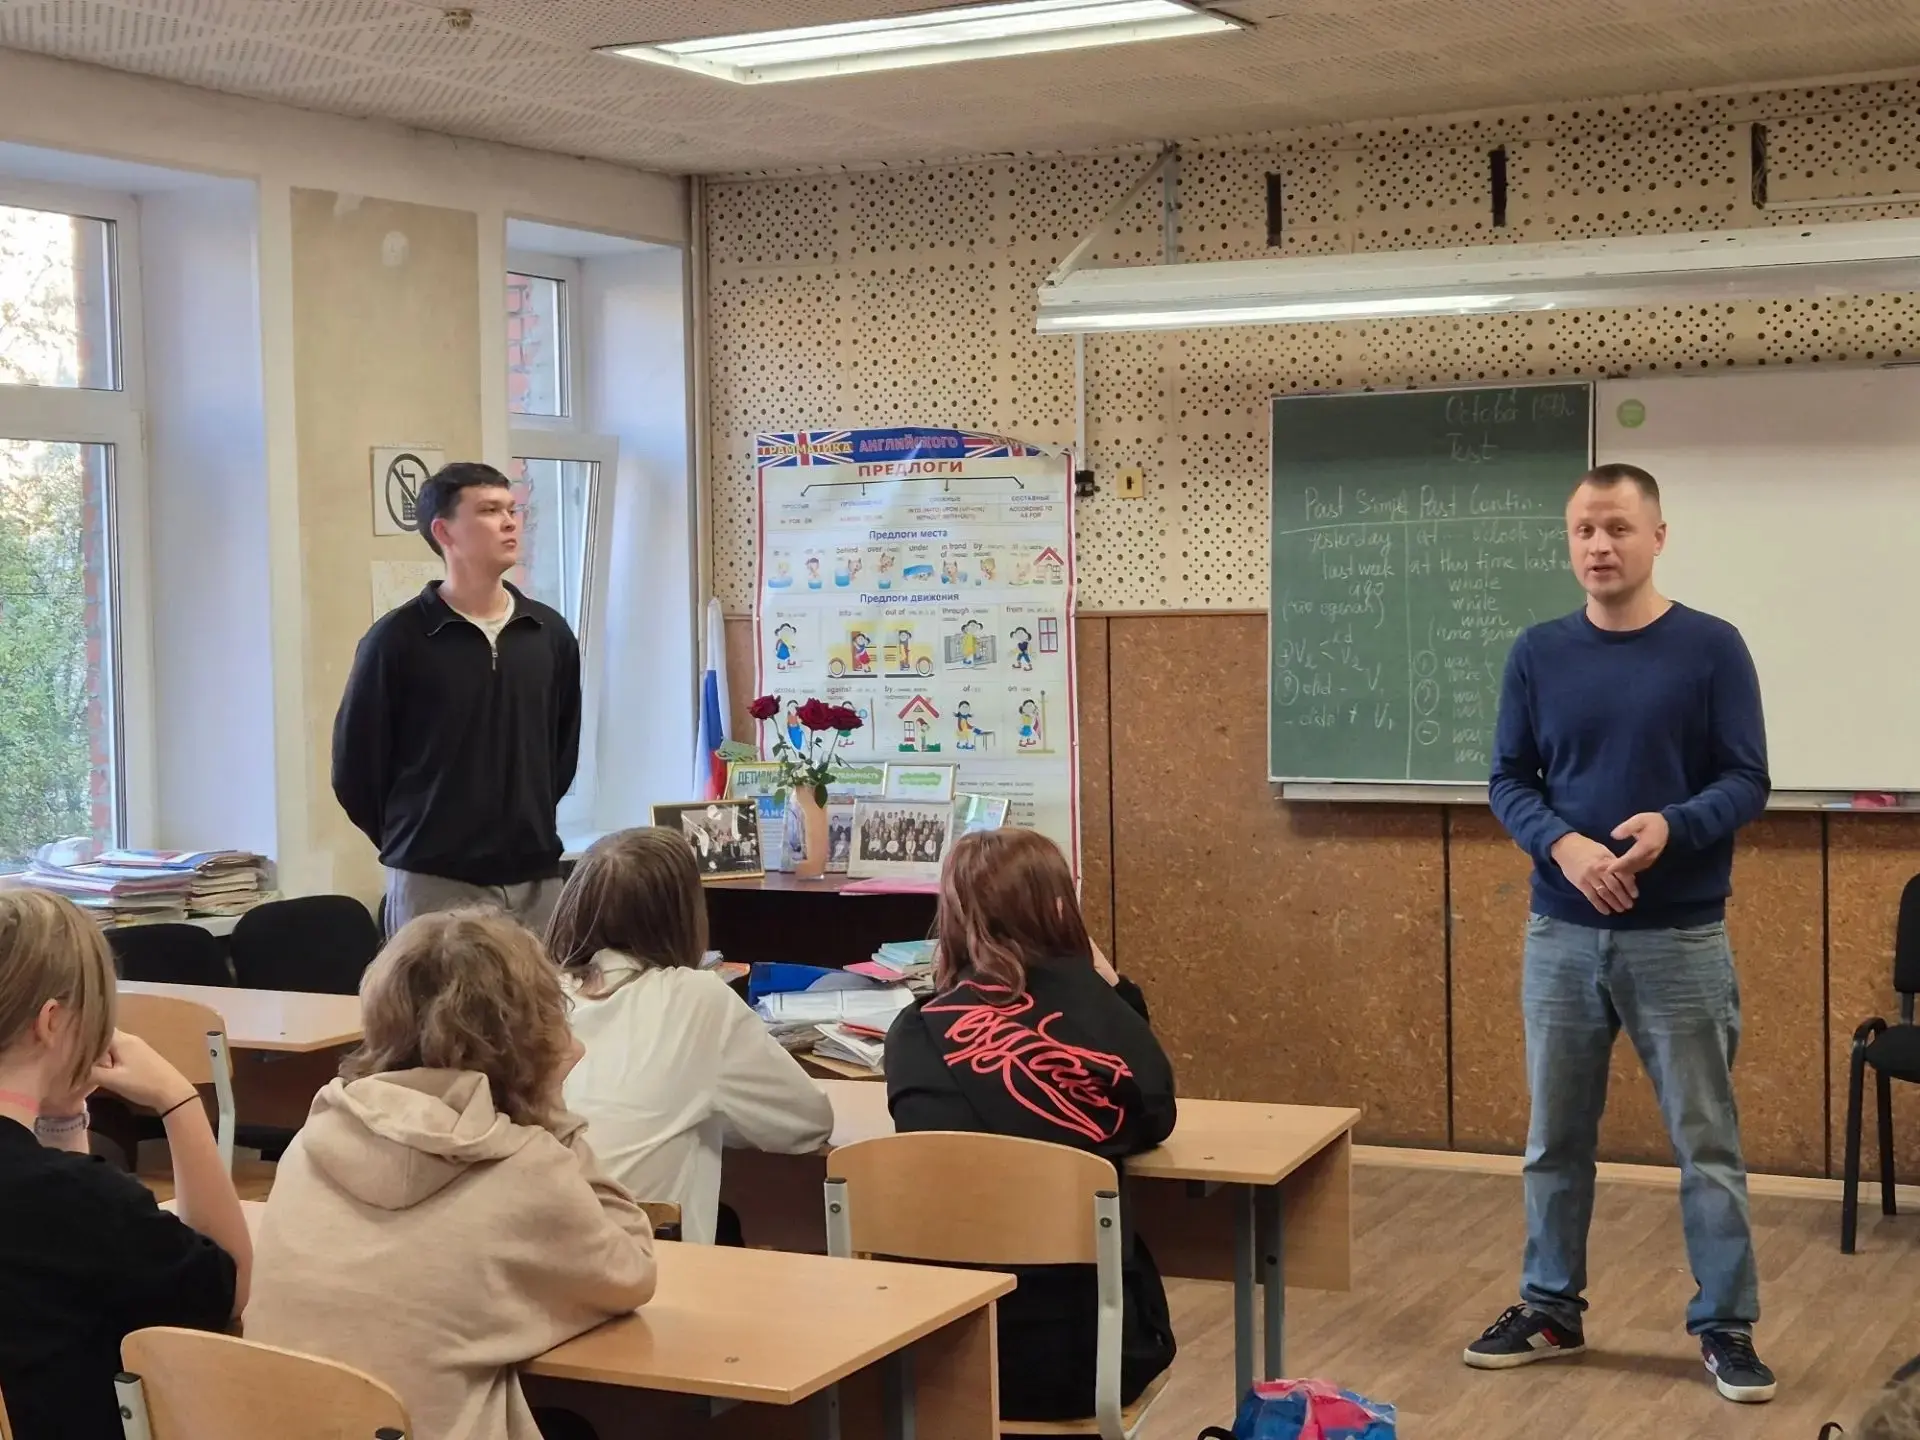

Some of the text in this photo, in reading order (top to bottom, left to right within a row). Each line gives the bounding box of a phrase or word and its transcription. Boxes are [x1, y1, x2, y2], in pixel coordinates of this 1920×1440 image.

[760, 434, 958, 456] ГРАММАТИКА АНГЛИЙСКОГО
[1446, 431, 1498, 464] Test
[858, 461, 963, 477] ПРЕДЛОГИ
[1304, 486, 1344, 521] Past
[1420, 485, 1457, 520] Past
[869, 529, 948, 541] Предлоги места
[860, 593, 959, 604] Предлоги движения
